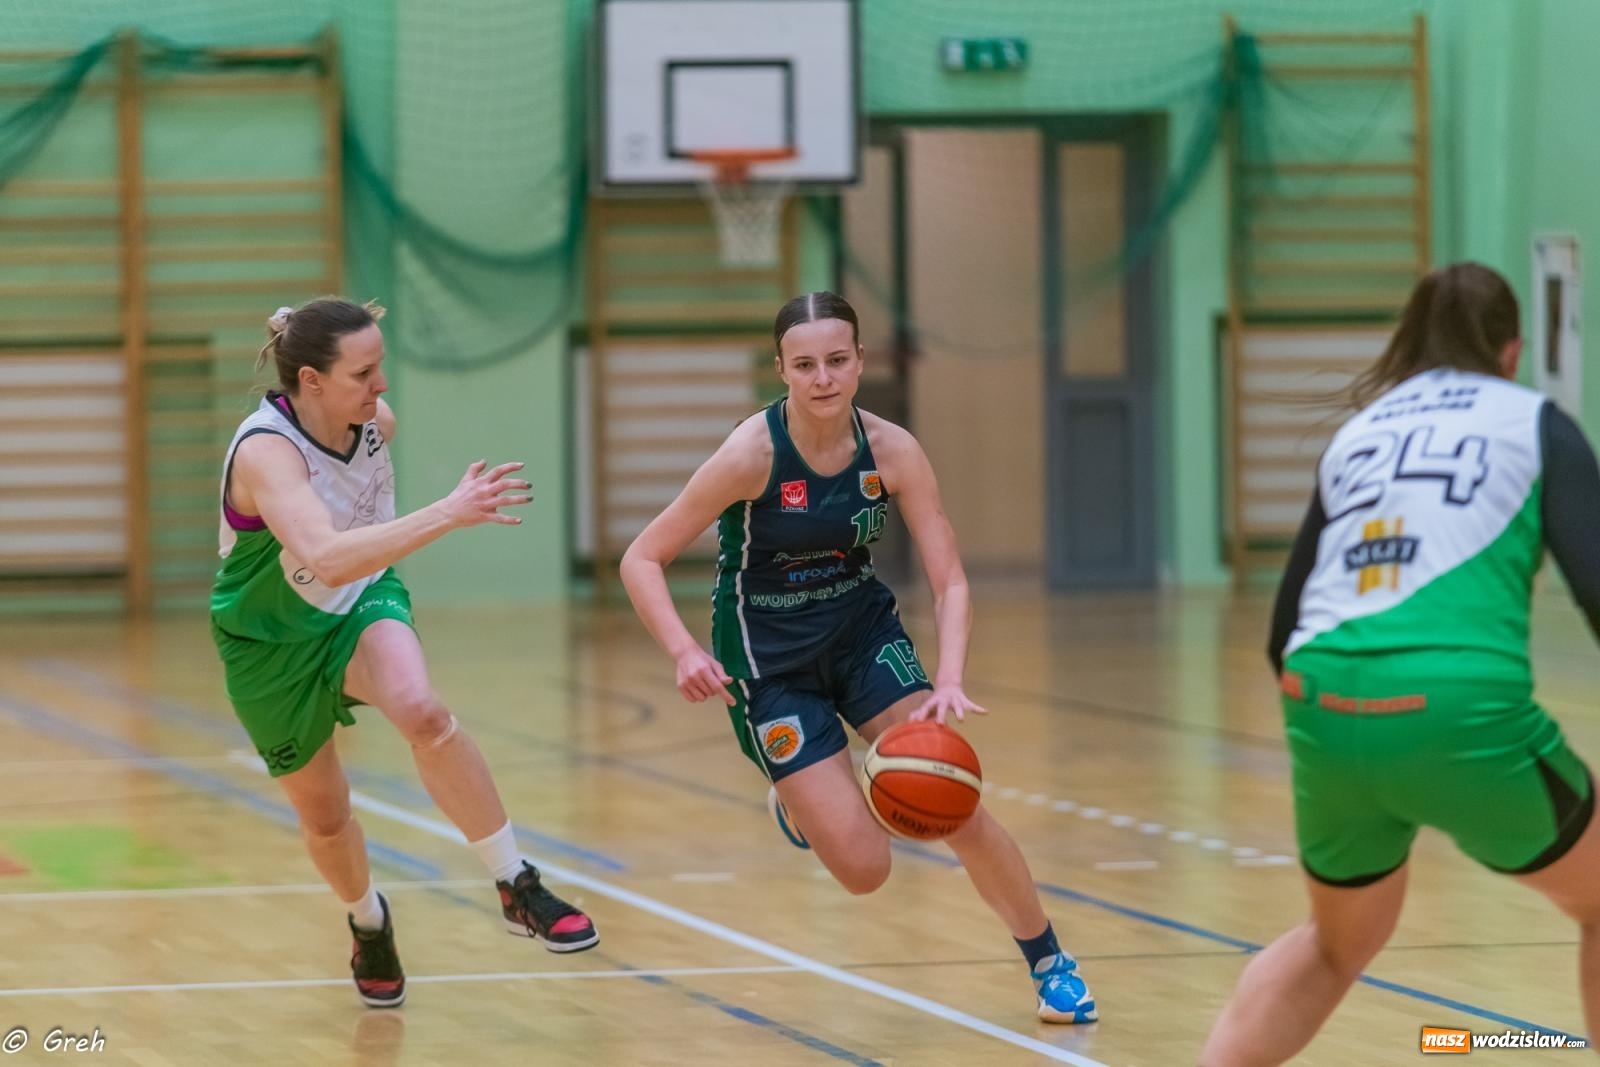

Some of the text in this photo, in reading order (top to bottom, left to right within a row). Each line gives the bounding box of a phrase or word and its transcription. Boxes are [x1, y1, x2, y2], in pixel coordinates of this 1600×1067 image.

[1327, 425, 1488, 525] 24
[851, 503, 888, 547] 15
[876, 639, 929, 687] 15
